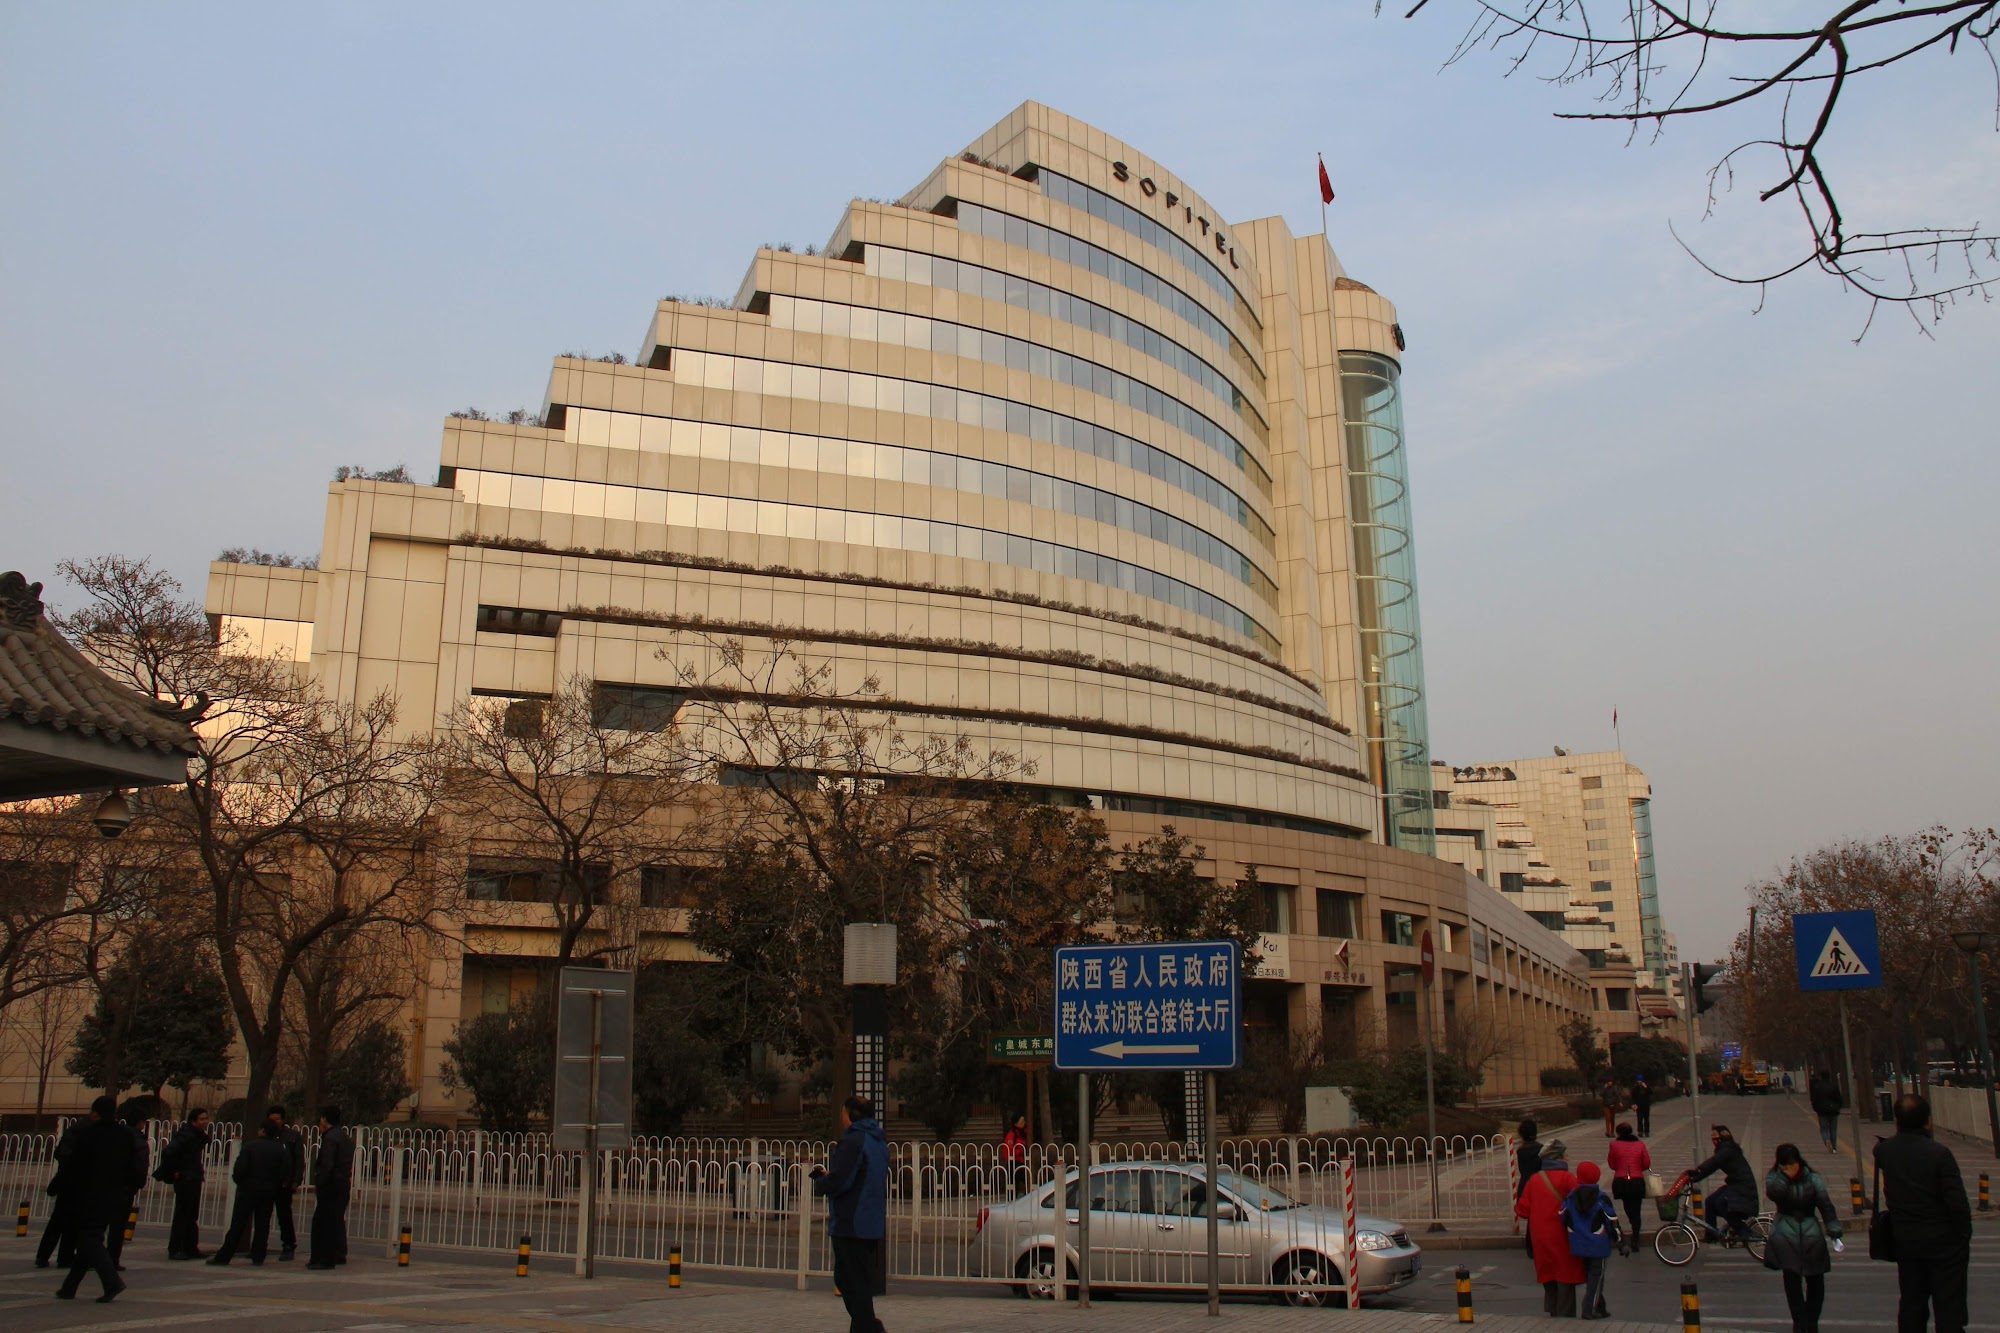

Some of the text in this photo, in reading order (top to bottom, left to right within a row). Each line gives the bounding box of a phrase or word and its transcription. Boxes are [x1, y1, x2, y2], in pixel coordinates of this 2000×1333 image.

[1113, 161, 1239, 270] SOFITEL
[1061, 952, 1229, 990] 陕西省人民政府
[1062, 998, 1229, 1034] 群众来访联合接待大厅
[1006, 1038, 1053, 1050] 皇城东路
